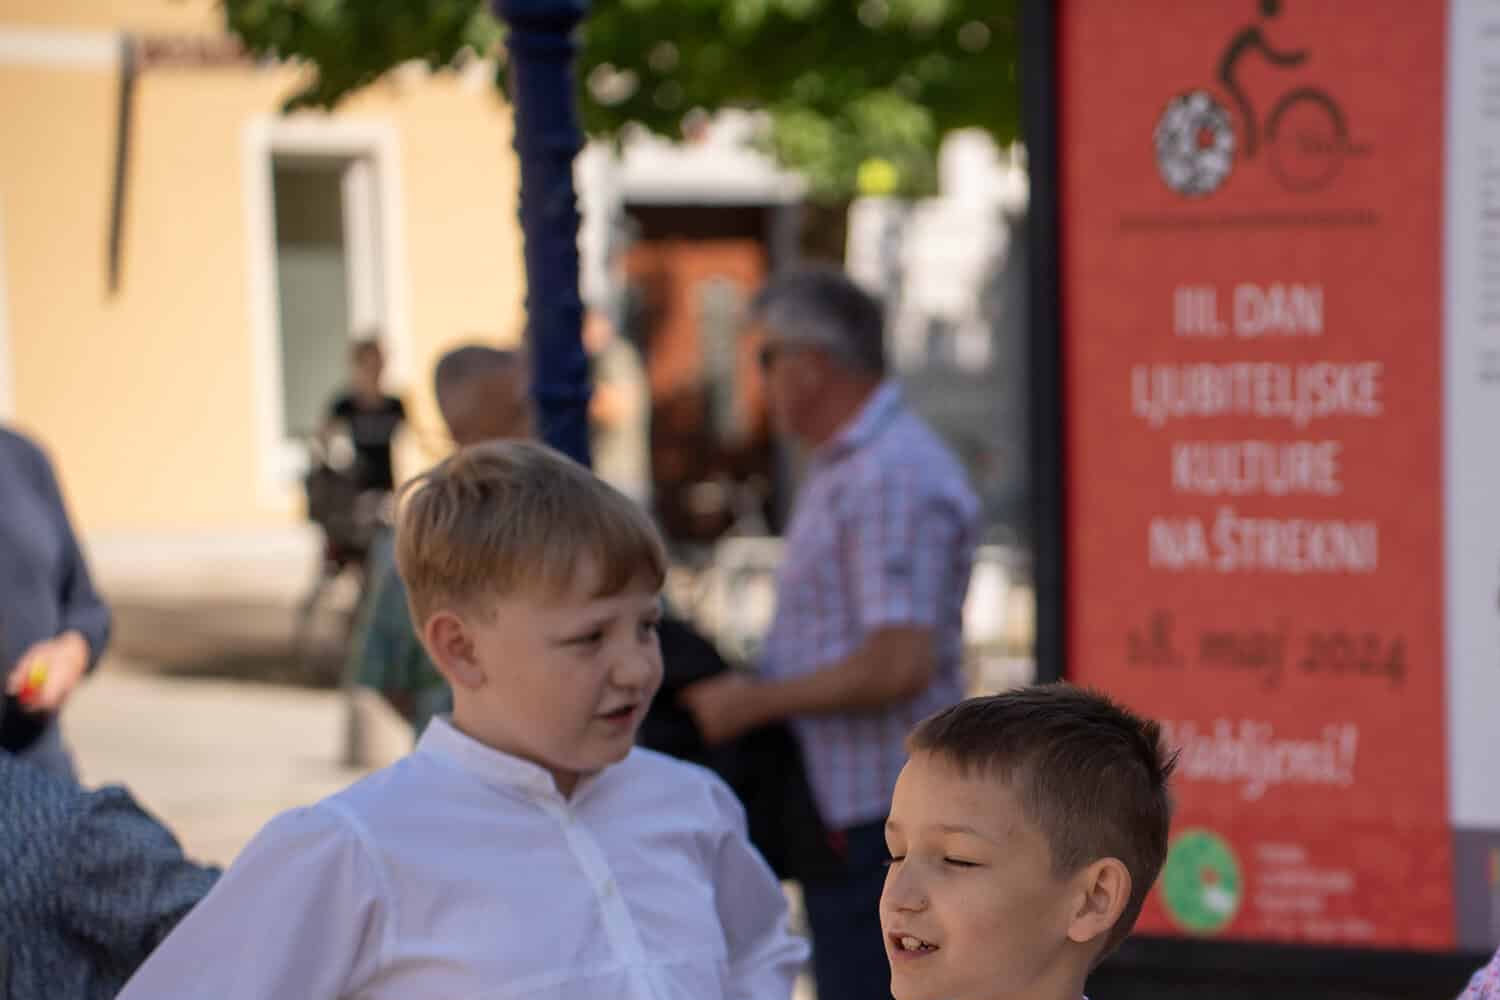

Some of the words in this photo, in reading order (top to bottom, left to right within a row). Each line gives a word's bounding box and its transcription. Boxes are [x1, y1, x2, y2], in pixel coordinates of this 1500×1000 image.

[1173, 283, 1227, 337] III.
[1234, 281, 1324, 338] DAN
[1131, 361, 1384, 430] LJUBITELJSKE
[1172, 440, 1343, 496] KULTURE
[1149, 515, 1208, 569] NA
[1211, 503, 1377, 572] ŠTREKNI
[1198, 615, 1291, 692] maj
[1297, 632, 1408, 692] 2024
